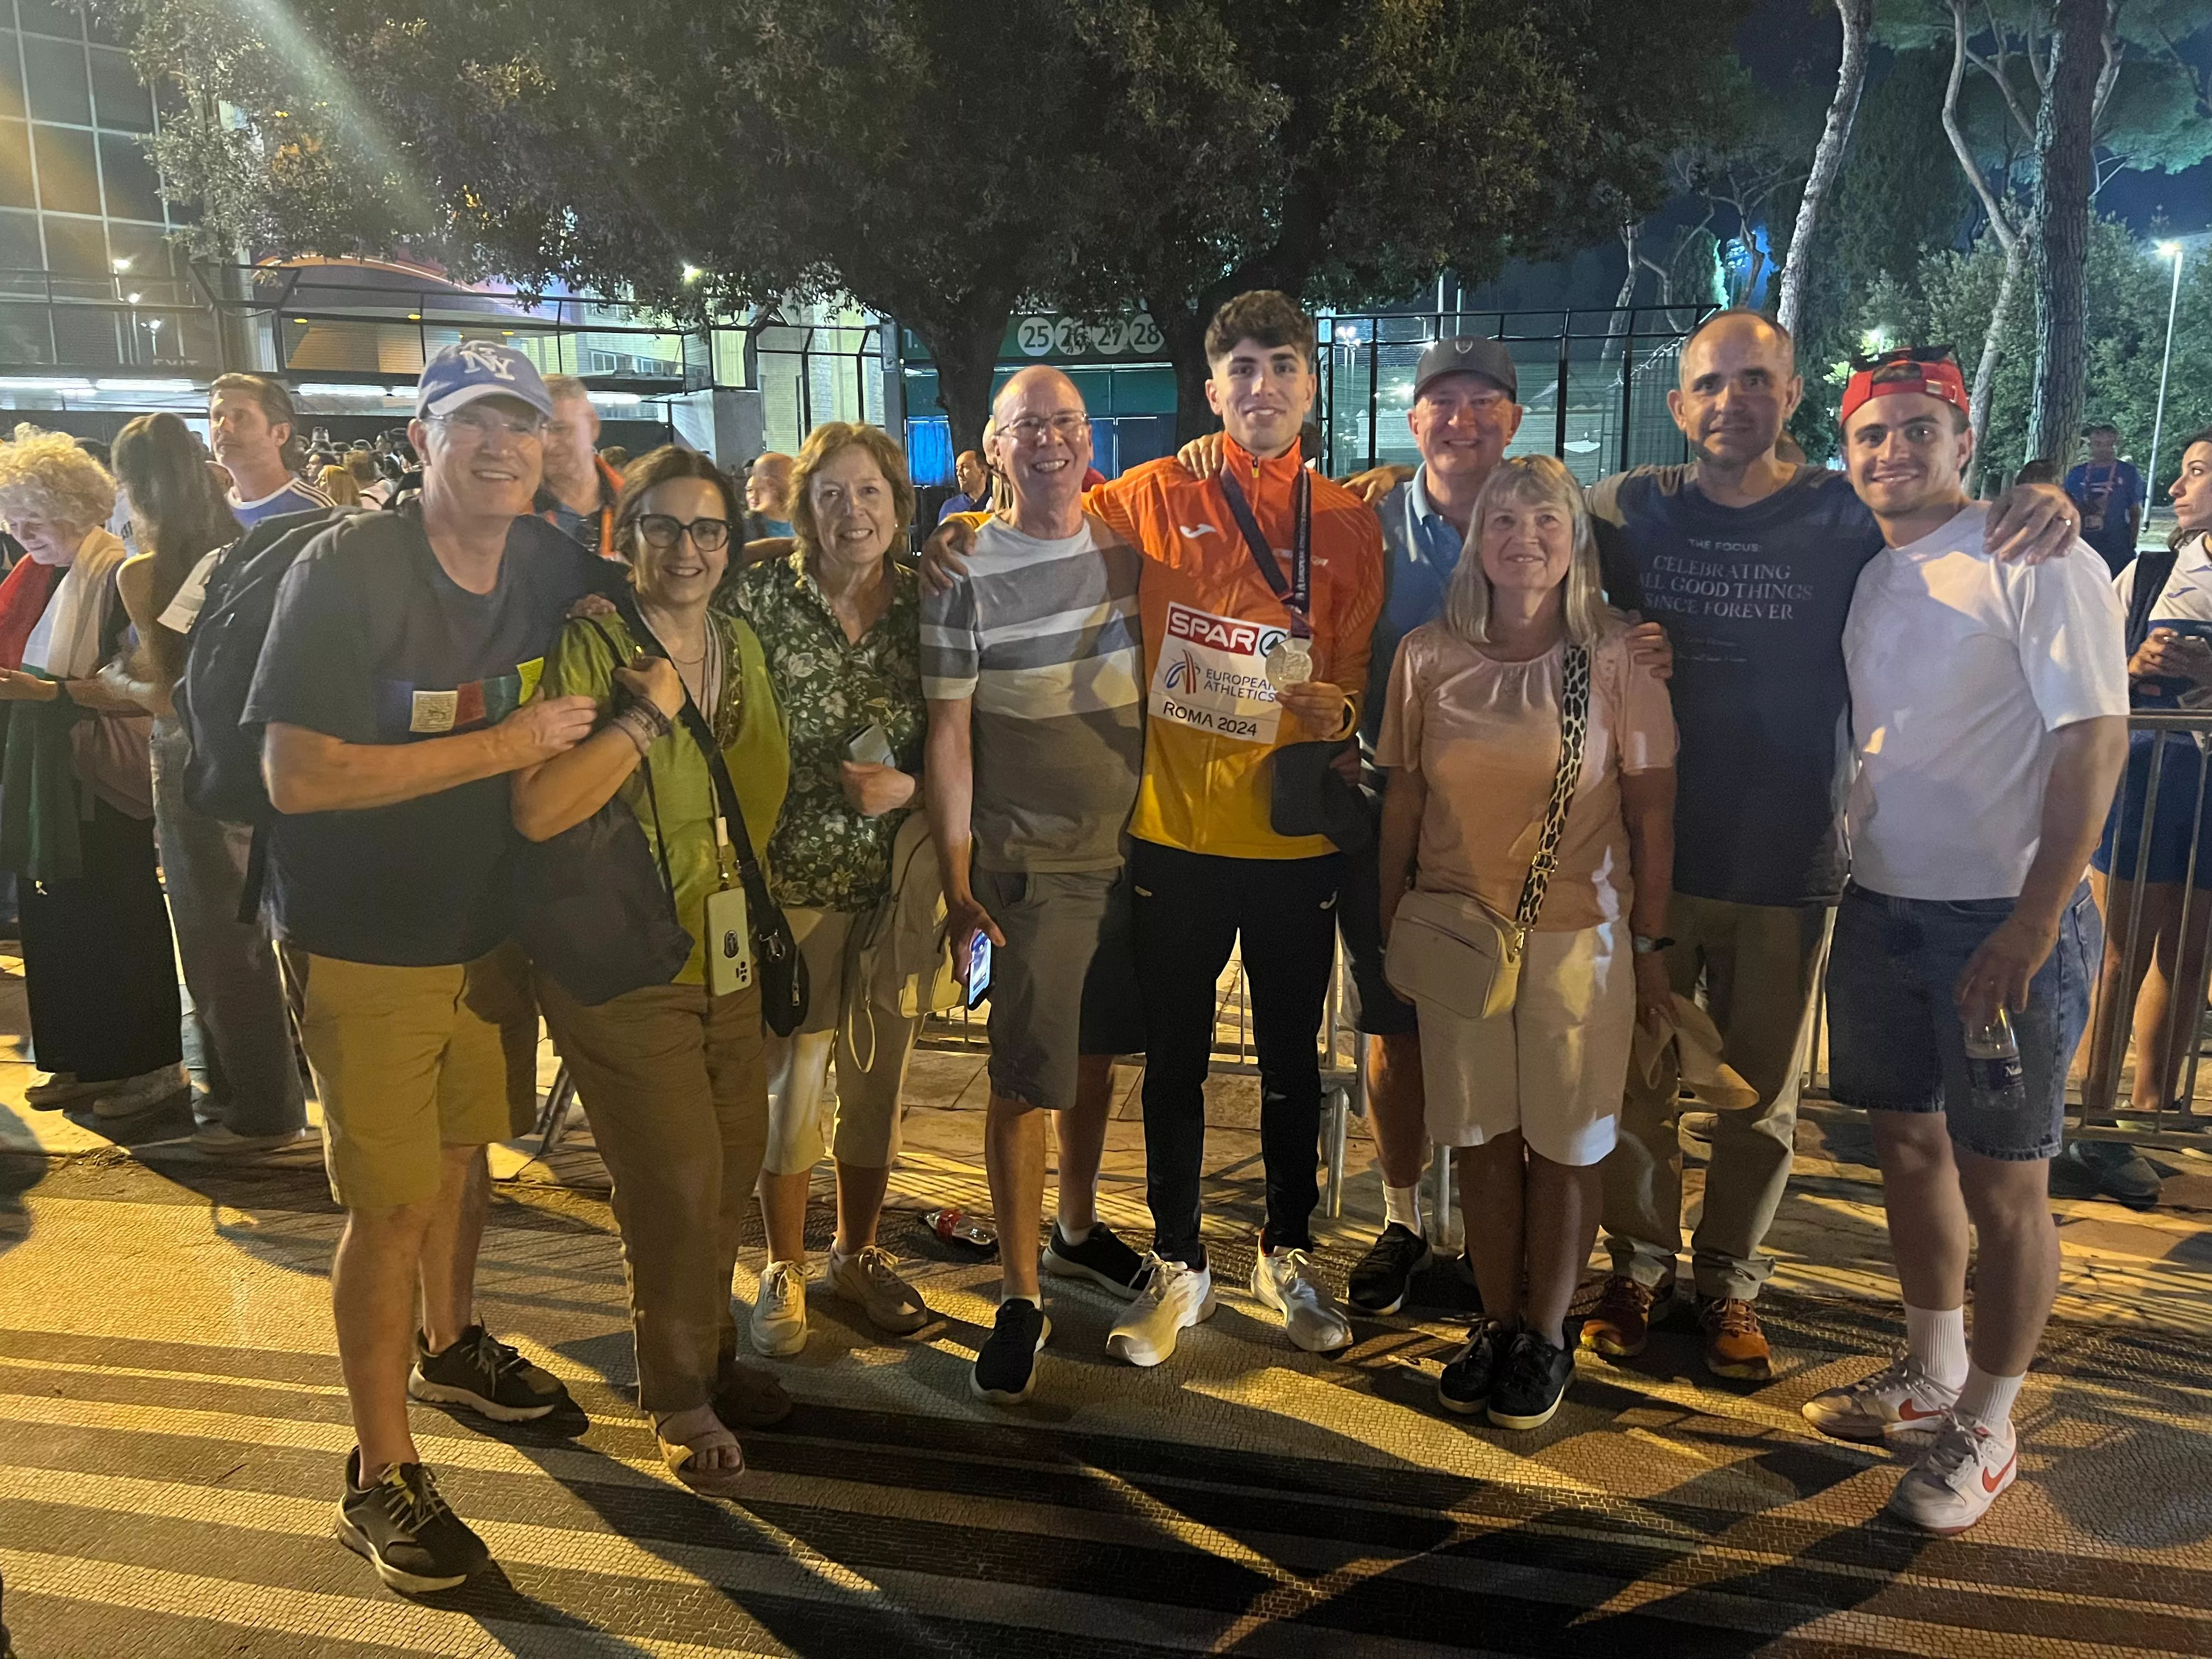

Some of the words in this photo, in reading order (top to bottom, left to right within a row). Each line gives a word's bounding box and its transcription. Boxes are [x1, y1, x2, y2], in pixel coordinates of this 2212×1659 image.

[1024, 325, 1049, 348] 25
[1098, 323, 1124, 346] 27
[1134, 323, 1160, 345] 28
[460, 347, 515, 380] NY
[1688, 538, 1712, 550] THE
[1654, 555, 1791, 579] CELEBRATING
[1671, 577, 1729, 597] GOOD
[1734, 583, 1813, 601] THINGS
[1645, 592, 1699, 614] SINCE
[1704, 602, 1793, 620] FOREVER
[1170, 612, 1256, 652] SPAR
[1204, 681, 1276, 702] ATHLETICS
[1164, 702, 1214, 728] ROMA
[1218, 717, 1258, 737] 2024
